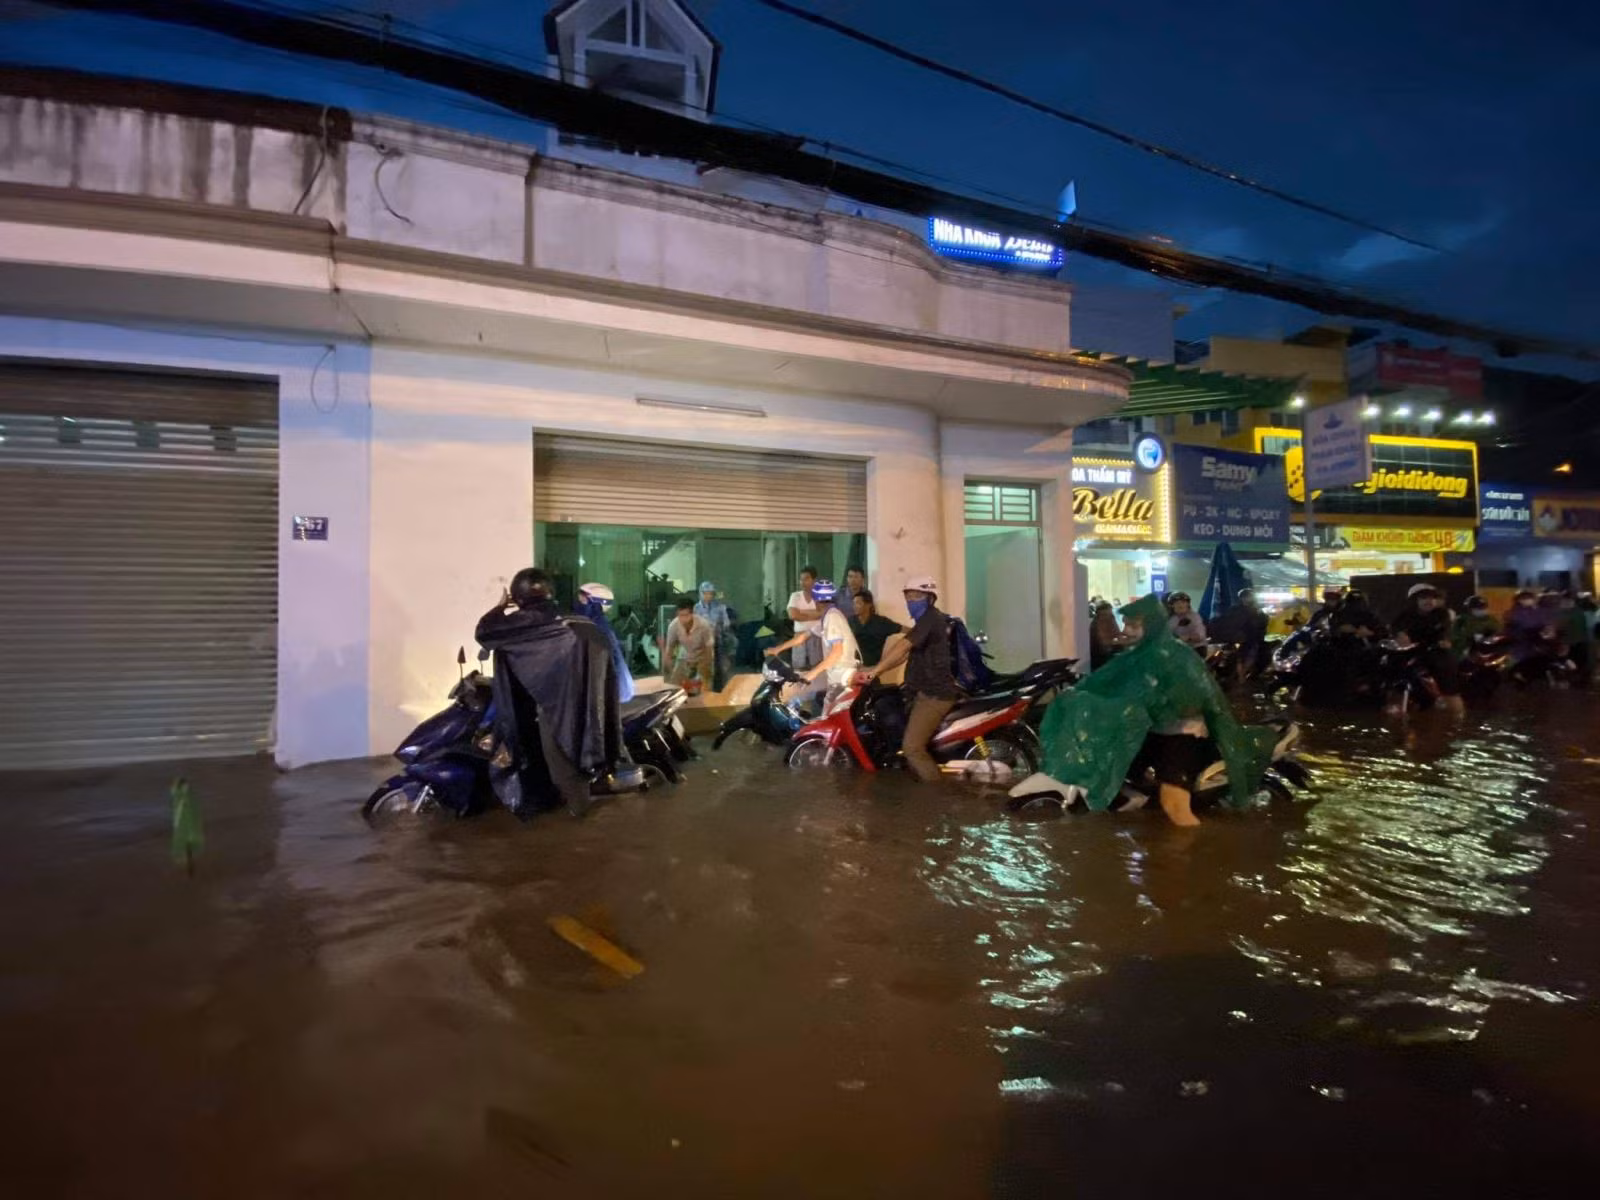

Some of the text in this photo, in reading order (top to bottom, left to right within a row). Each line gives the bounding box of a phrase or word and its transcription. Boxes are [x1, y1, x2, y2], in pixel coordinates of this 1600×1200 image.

[1072, 467, 1086, 482] OA
[1201, 456, 1256, 484] Samy
[1352, 468, 1468, 498] gioididong
[1072, 487, 1154, 522] Bella
